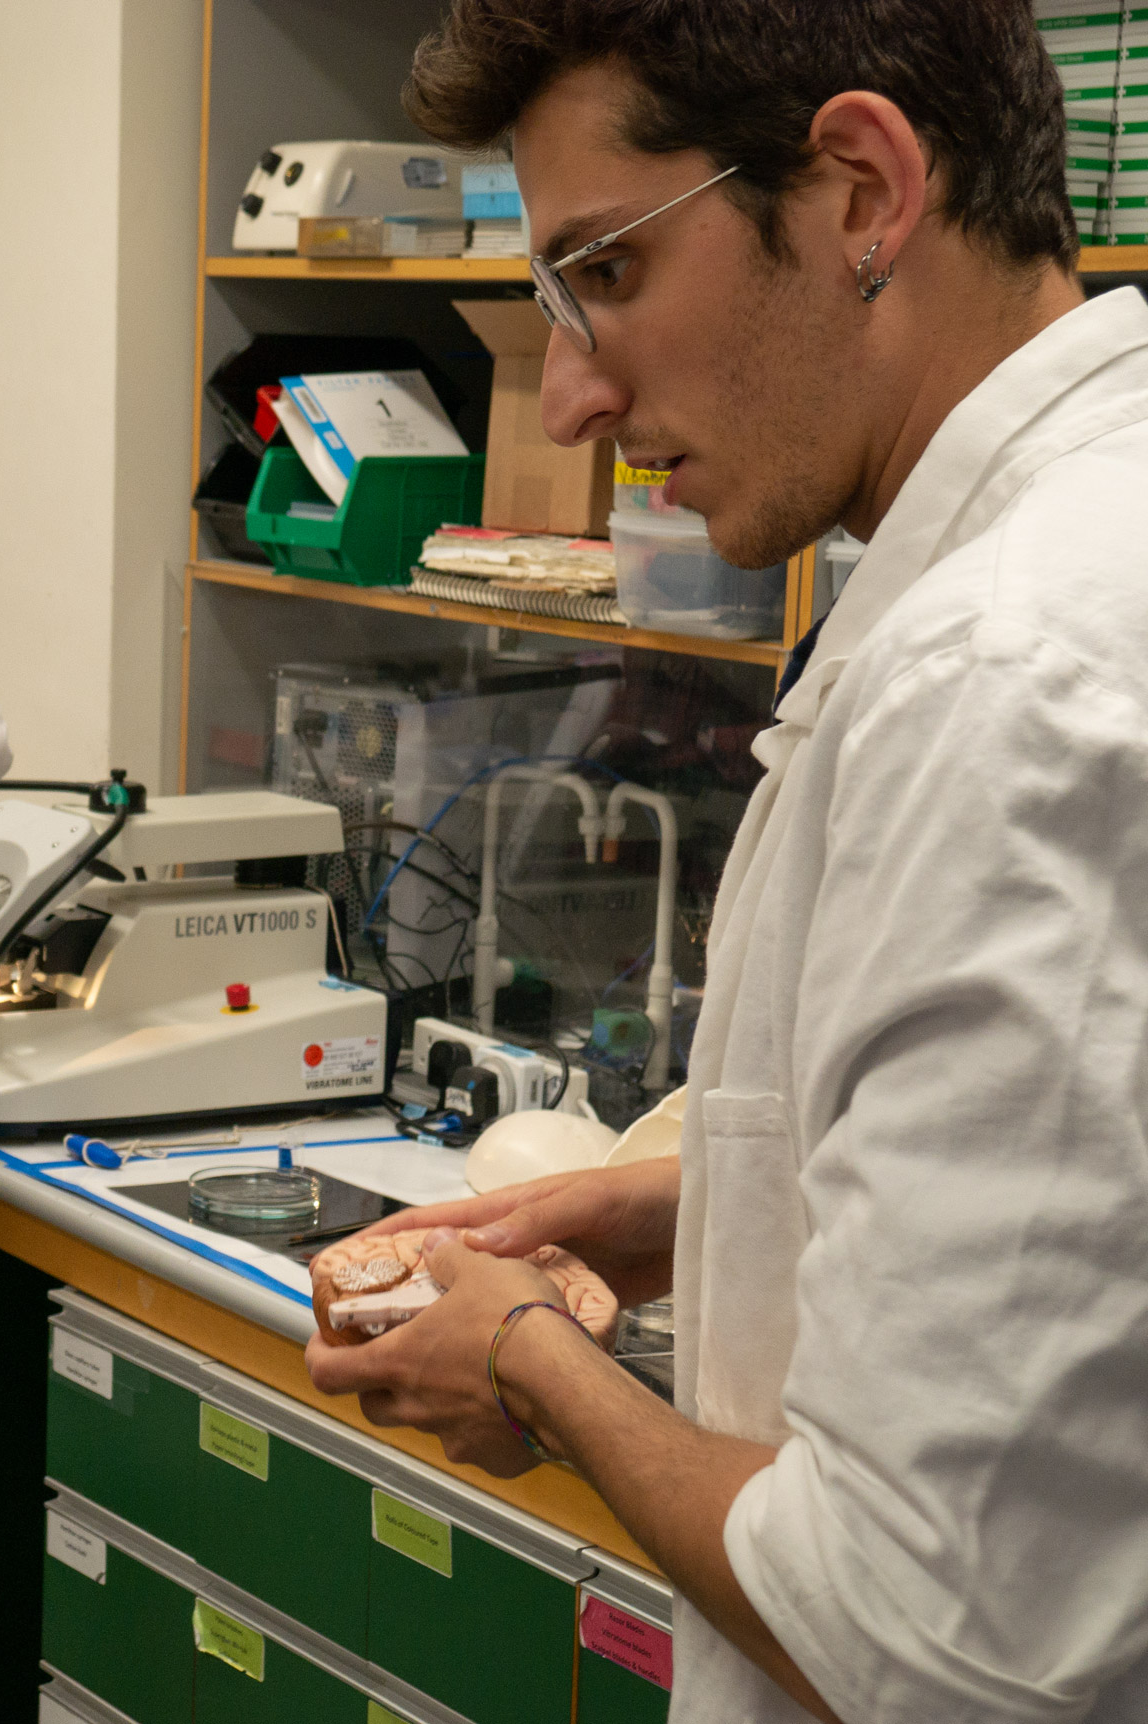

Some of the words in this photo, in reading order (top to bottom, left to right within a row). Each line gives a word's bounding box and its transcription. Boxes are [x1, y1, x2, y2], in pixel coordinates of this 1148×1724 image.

[376, 399, 392, 418] 1
[175, 915, 228, 938] LEICA
[234, 910, 299, 934] VT1000
[306, 909, 317, 929] S
[306, 1078, 352, 1090] VIBRATOME
[355, 1075, 373, 1086] LINE
[626, 1620, 645, 1636] Blades
